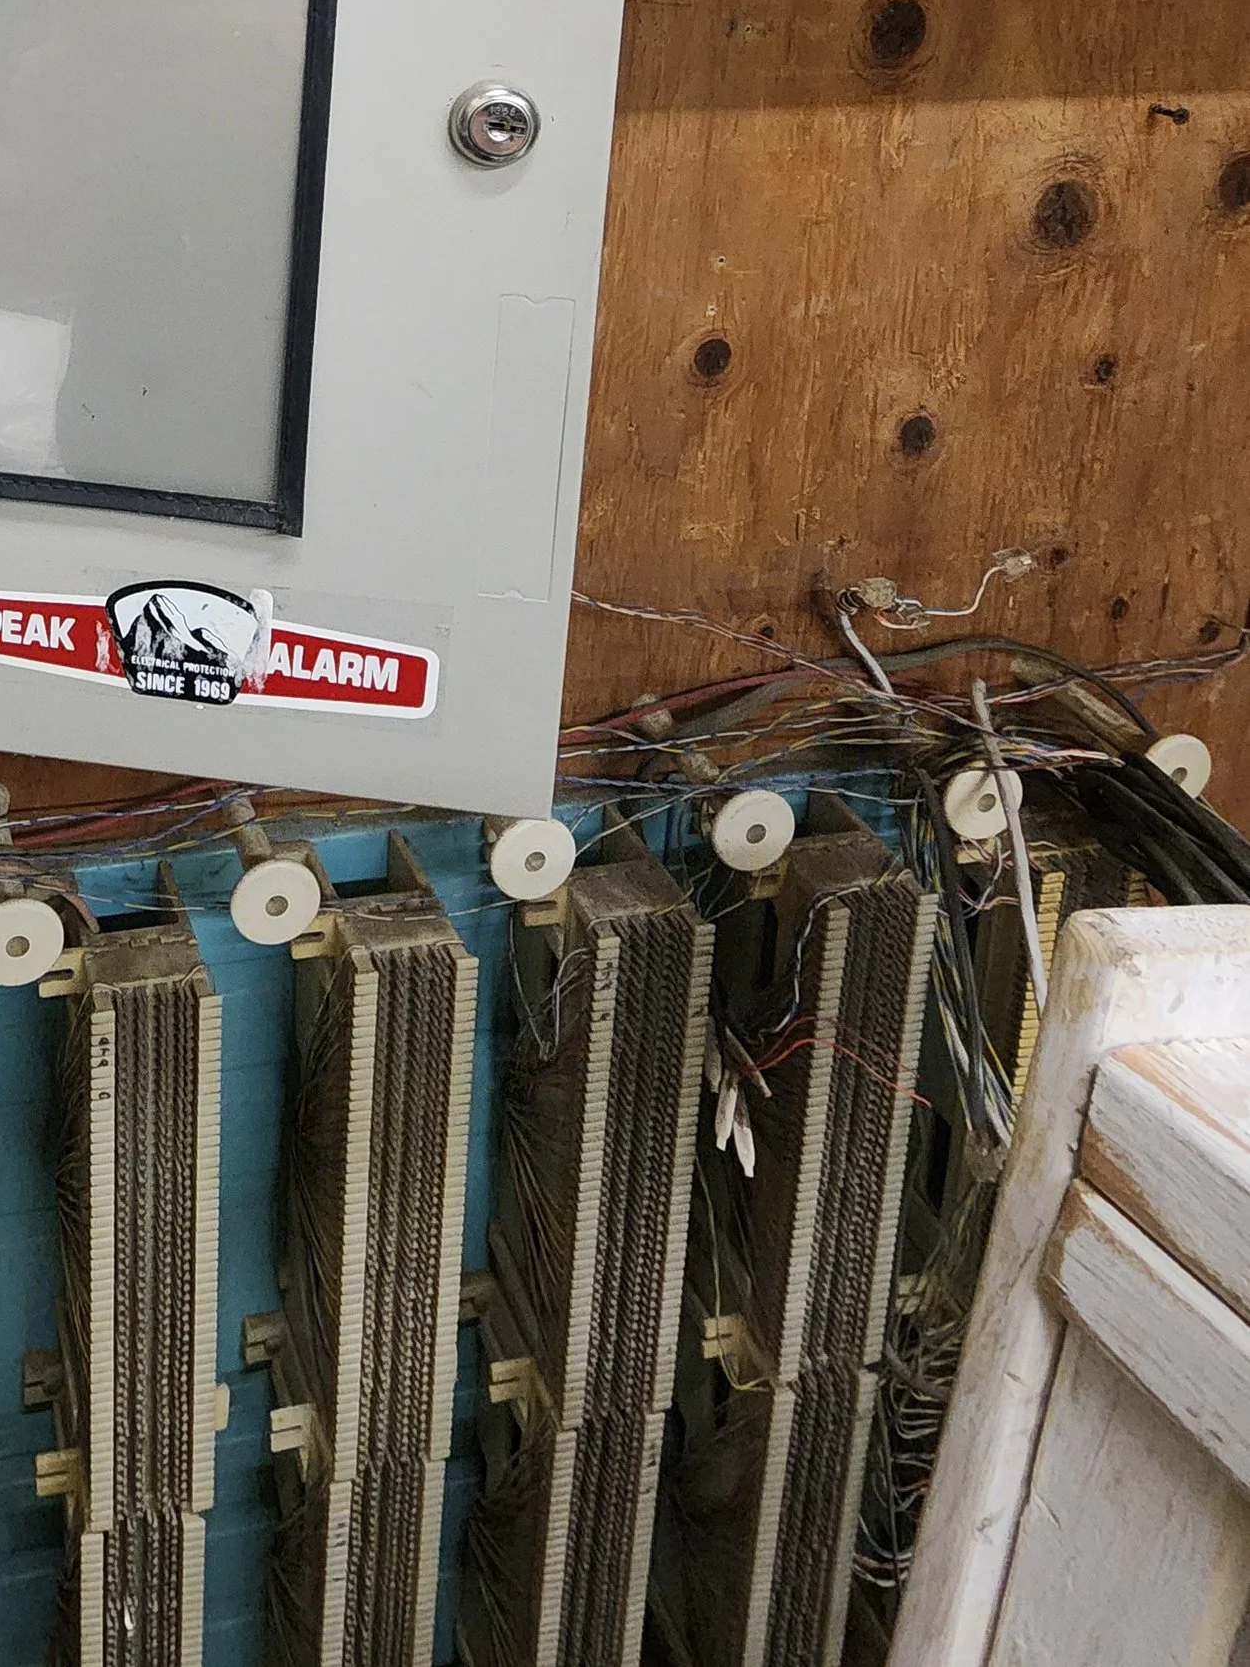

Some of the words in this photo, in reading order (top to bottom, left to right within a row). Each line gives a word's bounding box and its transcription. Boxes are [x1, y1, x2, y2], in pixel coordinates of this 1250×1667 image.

[130, 654, 181, 671] ELETRICAL
[266, 641, 400, 693] ALARM
[135, 671, 186, 695] SINCE
[193, 678, 231, 701] 1969
